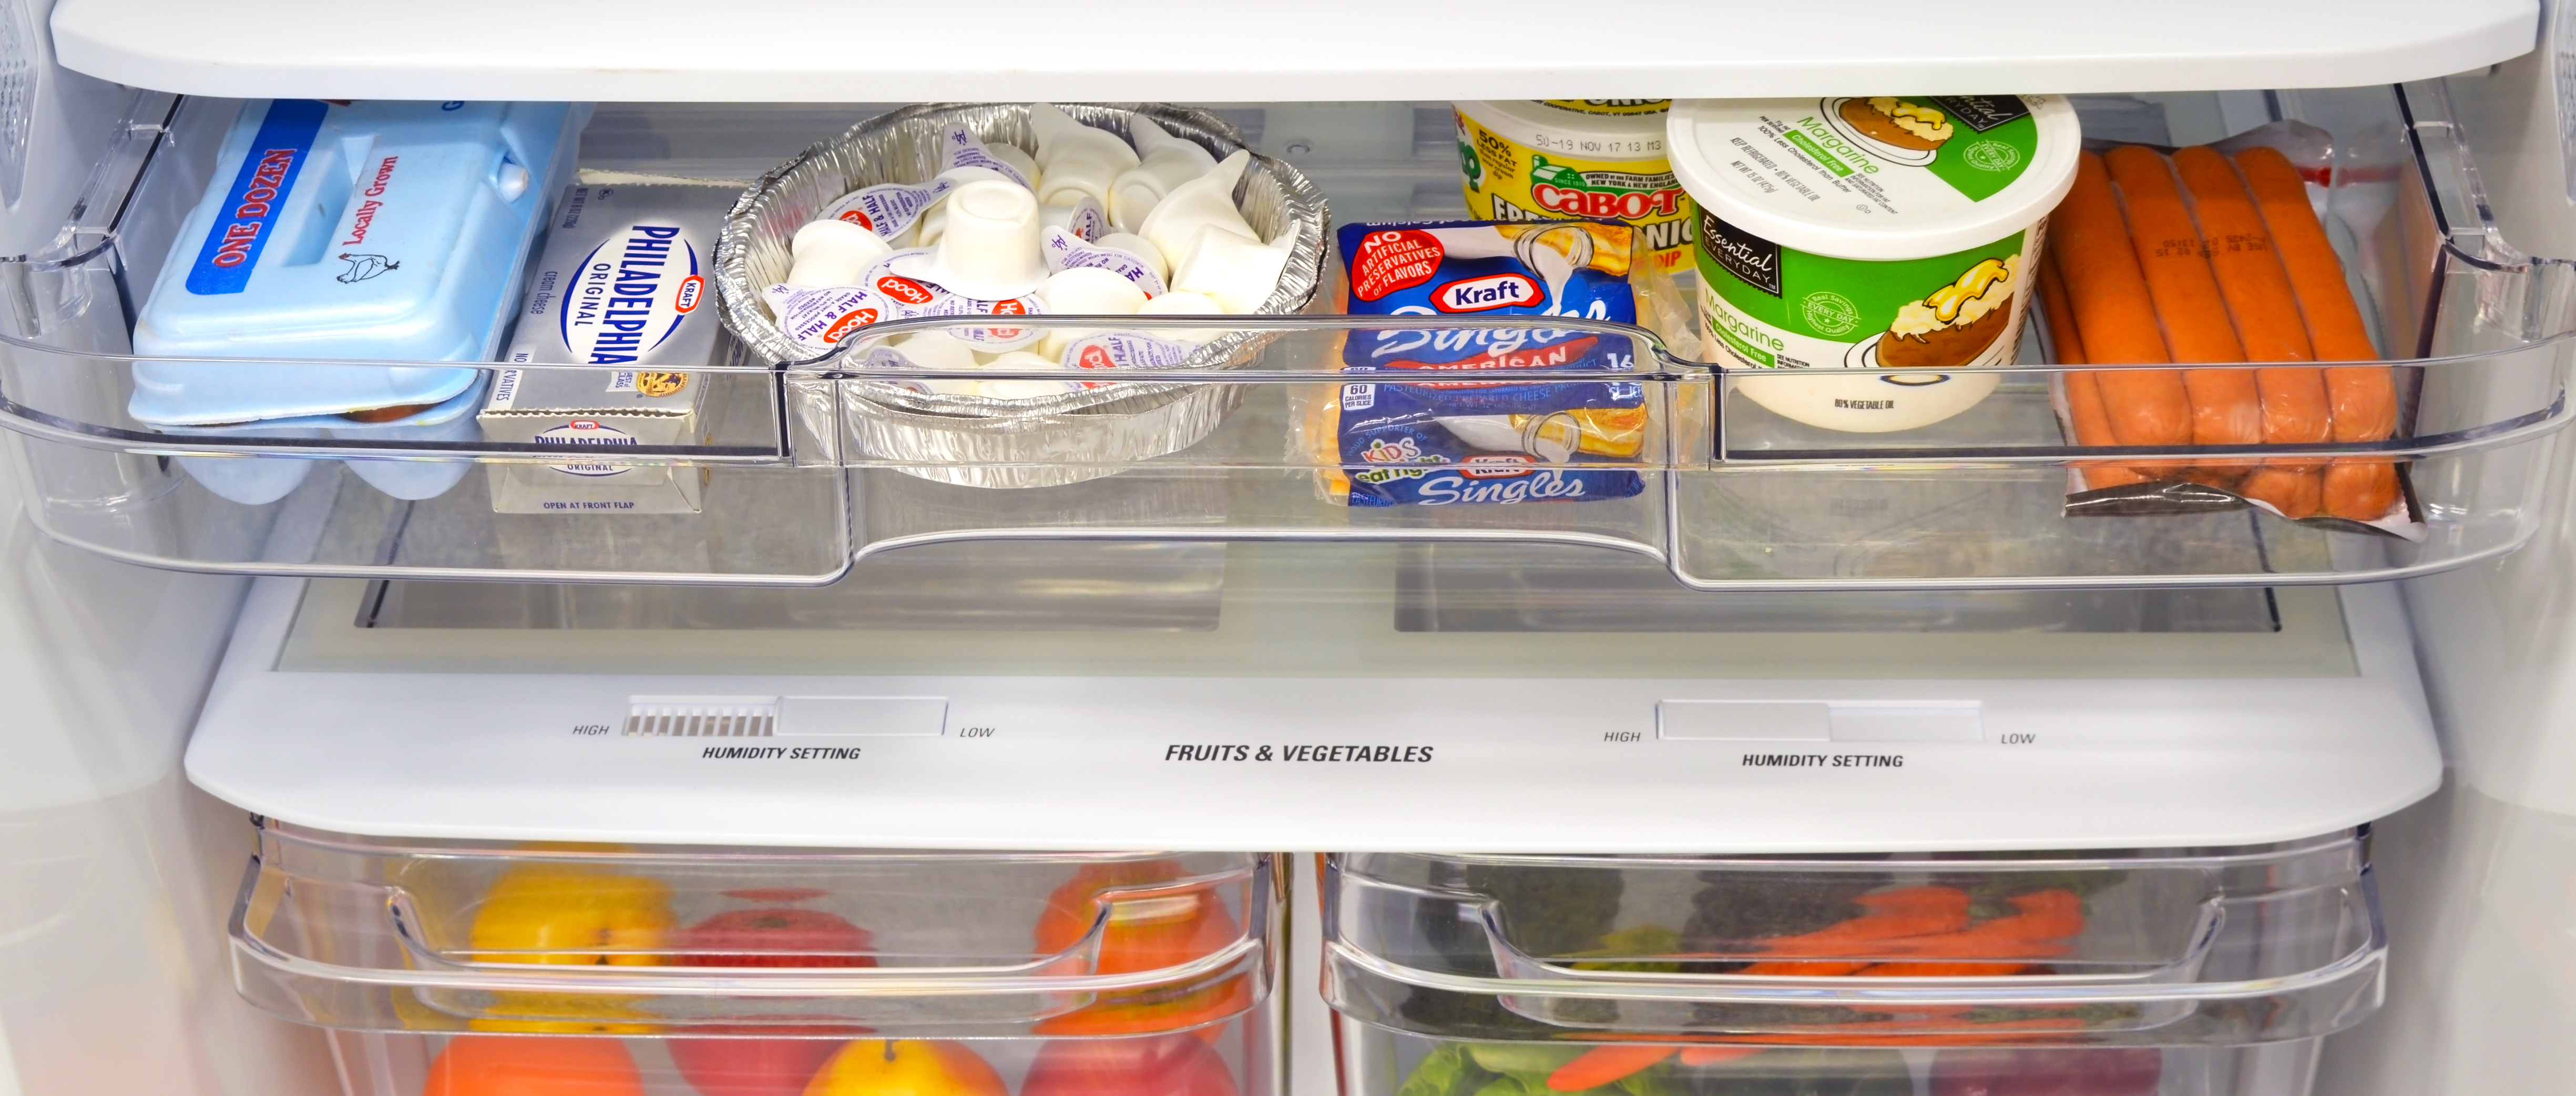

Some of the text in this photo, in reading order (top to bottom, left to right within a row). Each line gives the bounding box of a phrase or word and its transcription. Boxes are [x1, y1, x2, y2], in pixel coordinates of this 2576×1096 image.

[1476, 139, 1517, 167] LESS FAT
[1479, 129, 1511, 157] 50%
[1580, 141, 1601, 151] NOV
[1608, 142, 1621, 152] 17
[1628, 142, 1641, 151] 13
[1647, 140, 1661, 150] M3
[1792, 134, 1844, 172] Cholesterol Free
[1797, 116, 1879, 174] Margarine
[1479, 148, 1515, 172] than regular
[1757, 126, 1852, 194] 100% Less Cholesterol than Butter
[1981, 143, 2004, 169] EVERY DAY
[1482, 158, 1514, 179] sour cream
[1493, 171, 1502, 180] dip
[1645, 172, 1675, 182] FAMILIES
[1730, 137, 1747, 148] KEEP
[1741, 143, 1777, 171] REFRIGERATED
[1783, 173, 1815, 198] VEGETABLE
[1808, 193, 1821, 202] OIL
[1739, 166, 1753, 175] WT
[1555, 177, 1572, 186] SINCE
[1650, 178, 1678, 188] ENGLAN
[1851, 175, 1876, 194] INFORMATION
[1863, 177, 1885, 192] NUTRITION
[212, 149, 297, 268] ONE DOZEN
[342, 156, 398, 246] Locally Grown
[862, 194, 881, 215] HALF
[1878, 202, 1898, 215] CONTENT
[876, 221, 891, 237] HALF
[1364, 231, 1402, 253] NO
[1703, 215, 1772, 271] Essential
[1362, 239, 1423, 275] ARTIFICIAL
[1654, 250, 1682, 268] DIP
[1705, 236, 1770, 283] EVERYDAY
[1358, 247, 1441, 297] PRESERVATIVES
[1373, 261, 1433, 296] or FLAVORS
[530, 271, 558, 314] cream cheese
[574, 263, 611, 326] ORIGINAL
[588, 226, 680, 364] PHILADELPHIA
[679, 282, 697, 308] KRAFT
[835, 292, 851, 303] GRADE
[881, 279, 928, 303] Hood
[1455, 281, 1520, 306] Kraft
[790, 295, 823, 320] REFRIGERATION
[798, 298, 816, 310] NEEDED
[802, 305, 820, 319] MILKFAT
[1807, 302, 1854, 323] EVERY DAY
[1831, 295, 1853, 315] Savings
[795, 311, 821, 331] PROCESSED
[797, 291, 867, 341] HALF & HALF
[827, 311, 875, 342] Hood
[1705, 288, 1784, 351] Margarine
[1806, 310, 1850, 333] Highest Quality
[1714, 335, 1725, 350] Less
[1725, 345, 1756, 369] Cholesterol
[1715, 323, 1767, 362] Cholesterol Free
[1607, 353, 1634, 369] 16
[1785, 356, 1810, 367] NUTRITION
[1345, 393, 1372, 402] CALORIES
[1350, 384, 1368, 395] 60
[1384, 383, 1451, 401] PASTEURIZED
[1512, 387, 1551, 402] CHEESE
[1834, 399, 1894, 410] 80% VEGETABLE OIL
[1347, 425, 1428, 456] PROUD SUPPORTER OF
[1418, 472, 1587, 506] Singles
[573, 725, 610, 735] HIGH
[959, 727, 996, 738] LOW
[1604, 732, 1641, 742] HIGH
[2001, 734, 2036, 744] LOW
[702, 747, 862, 760] HUMIDITY SETTING
[1165, 744, 1434, 762] FRUITS & VEGETABLES
[1743, 754, 1904, 768] HUMIDITY SETTING
